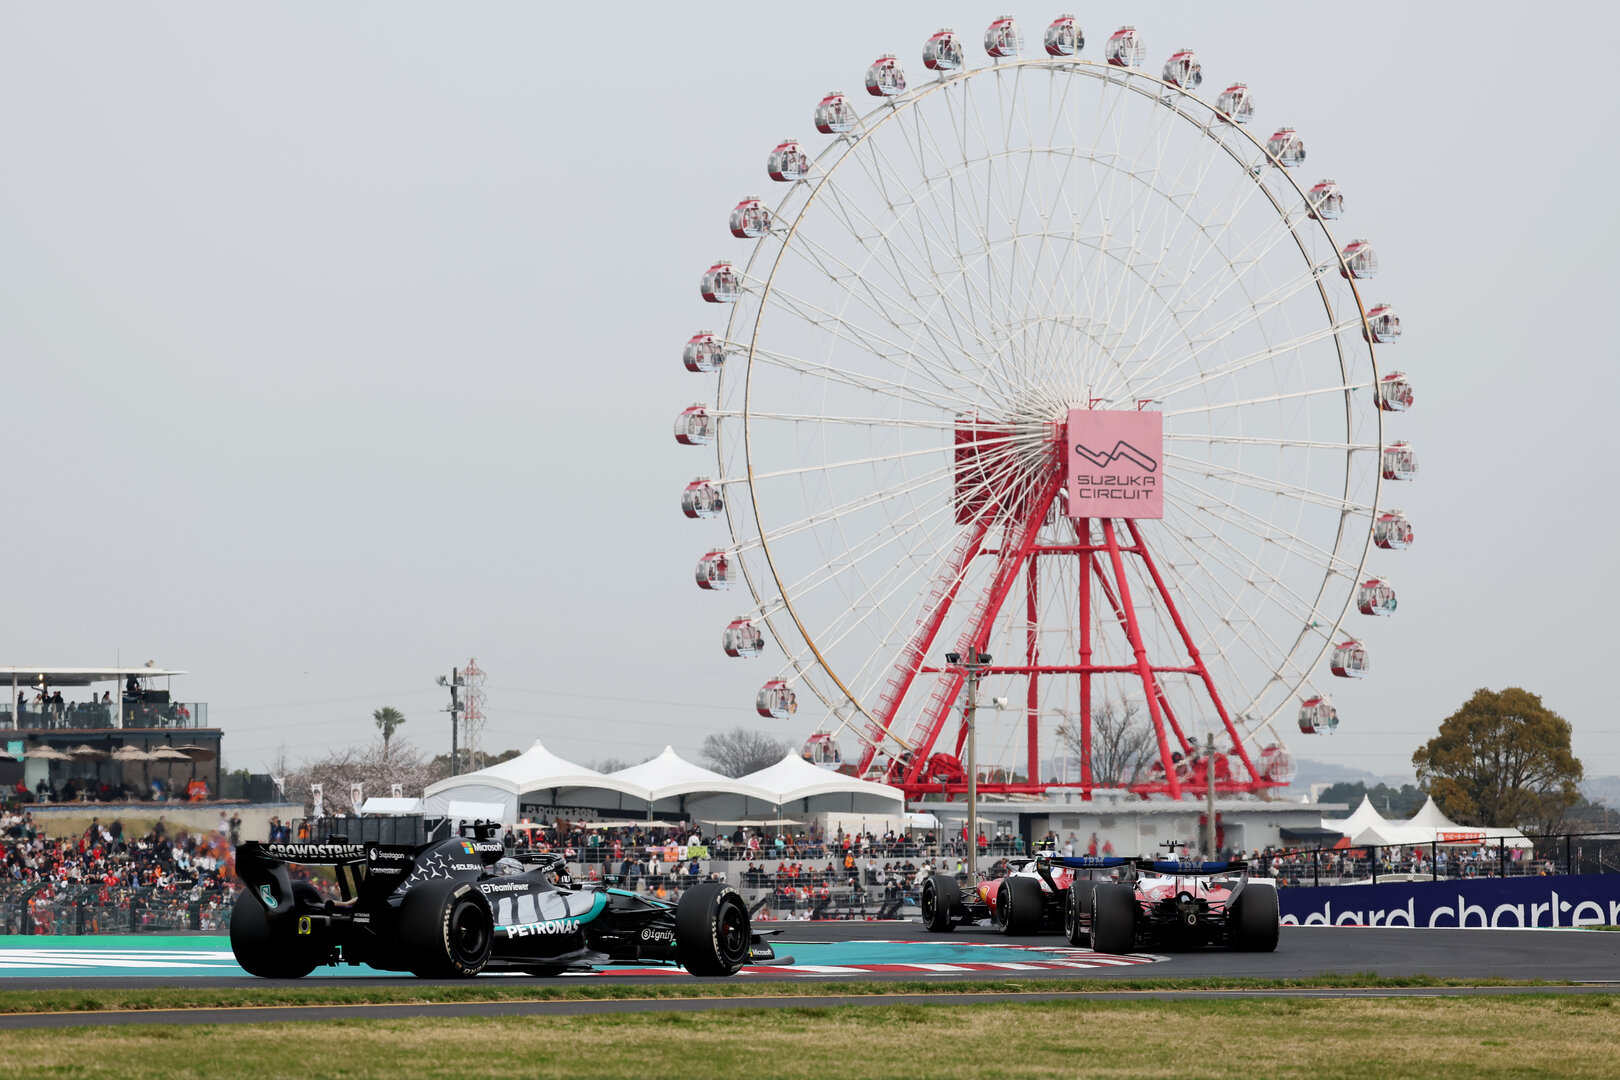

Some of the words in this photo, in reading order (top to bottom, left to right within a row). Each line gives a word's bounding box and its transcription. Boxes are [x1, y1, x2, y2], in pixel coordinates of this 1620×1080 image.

[1077, 475, 1156, 486] SUZUKA
[1079, 488, 1153, 500] CIRCUIT
[268, 844, 366, 858] CROWDSTRIKE
[473, 842, 503, 852] Microsoft
[378, 850, 405, 861] Snapdragon
[1083, 856, 1104, 867] IBM
[1177, 861, 1203, 872] IBM
[489, 882, 529, 892] TeamViewer
[1279, 897, 1415, 927] ndard
[505, 919, 580, 939] PETRONAS
[752, 948, 772, 956] Microsoft
